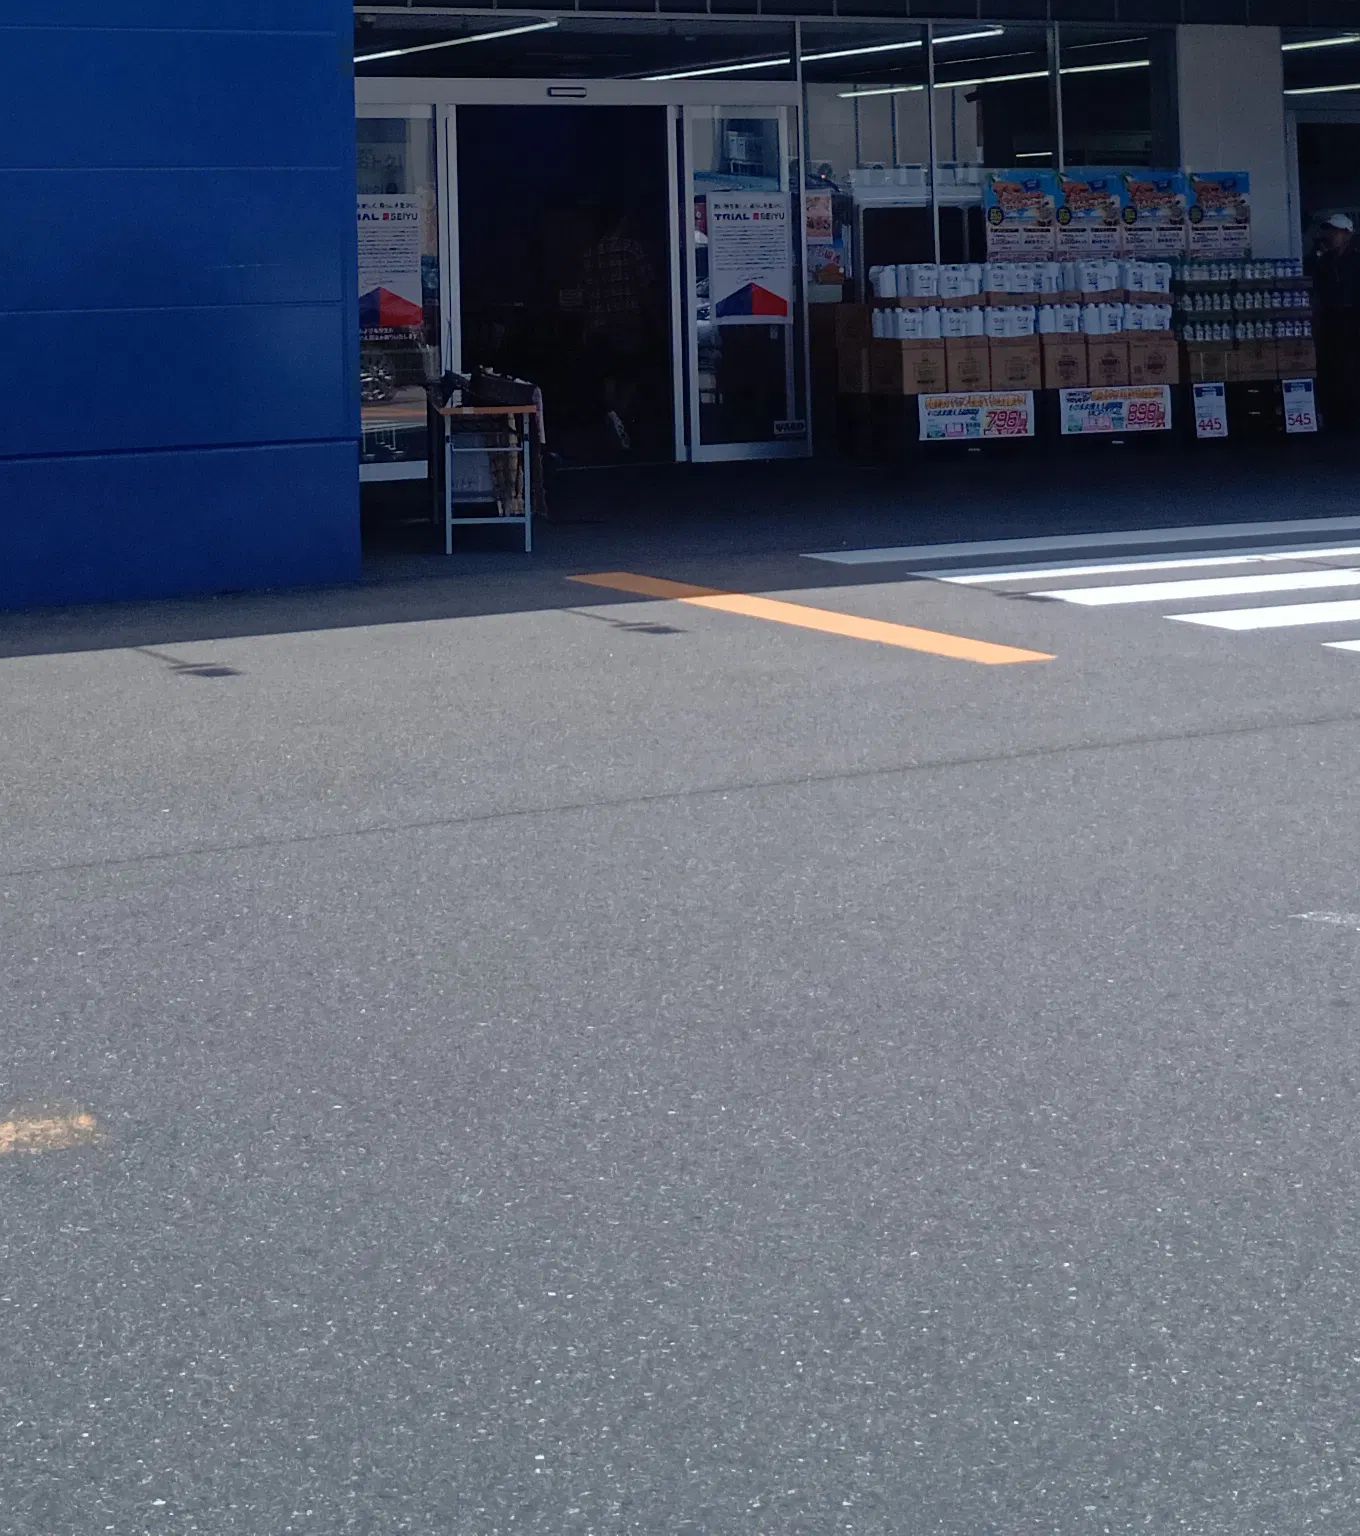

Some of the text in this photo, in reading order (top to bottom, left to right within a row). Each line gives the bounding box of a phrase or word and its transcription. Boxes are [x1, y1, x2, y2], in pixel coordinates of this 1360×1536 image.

[390, 212, 418, 221] SEIYU
[714, 212, 785, 221] TRIAL SEIYU
[986, 410, 1018, 429] 798
[1198, 418, 1222, 431] 445
[1288, 412, 1312, 426] 545
